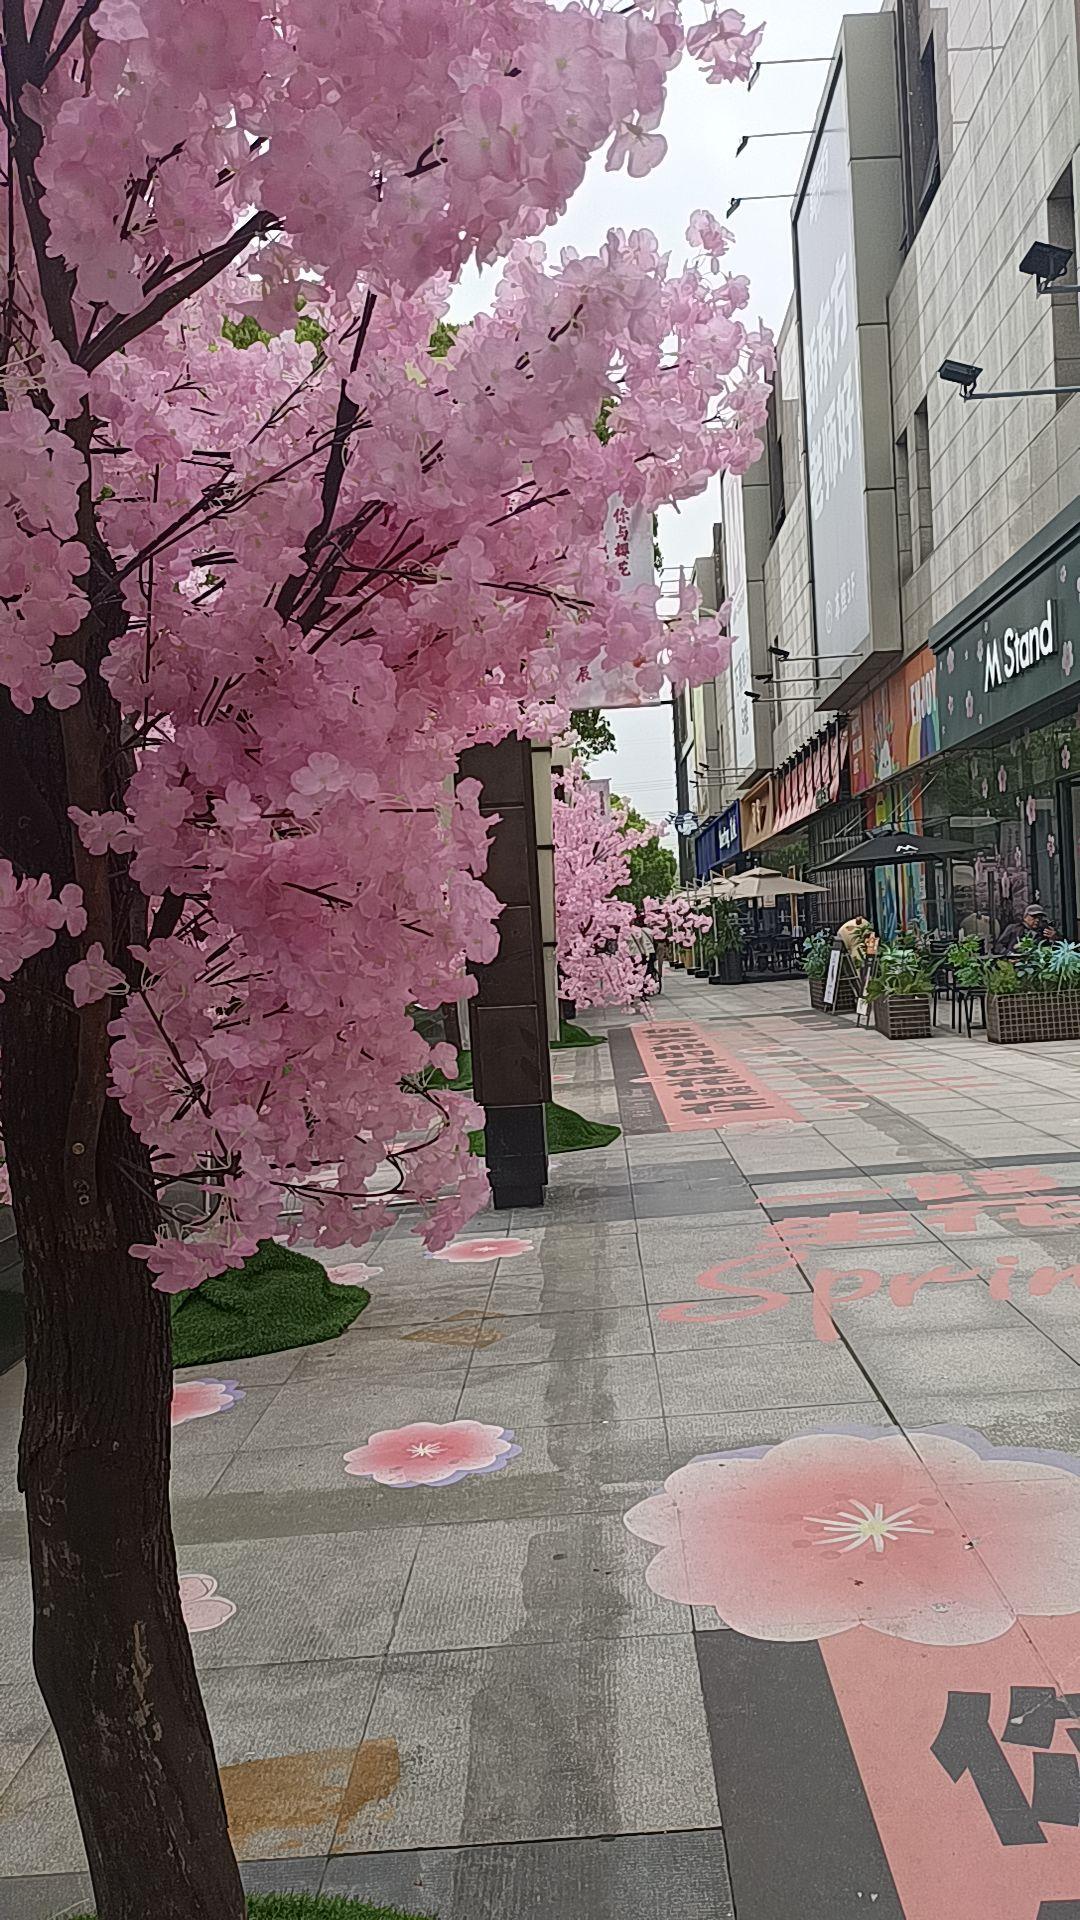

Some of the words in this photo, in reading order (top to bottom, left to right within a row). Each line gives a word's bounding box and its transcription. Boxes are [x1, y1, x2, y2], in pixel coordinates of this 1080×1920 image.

[805, 251, 848, 427] 新东方
[810, 361, 855, 521] 老师好
[910, 667, 937, 724] ENJOY
[984, 638, 1002, 693] M
[1004, 599, 1053, 678] Stand
